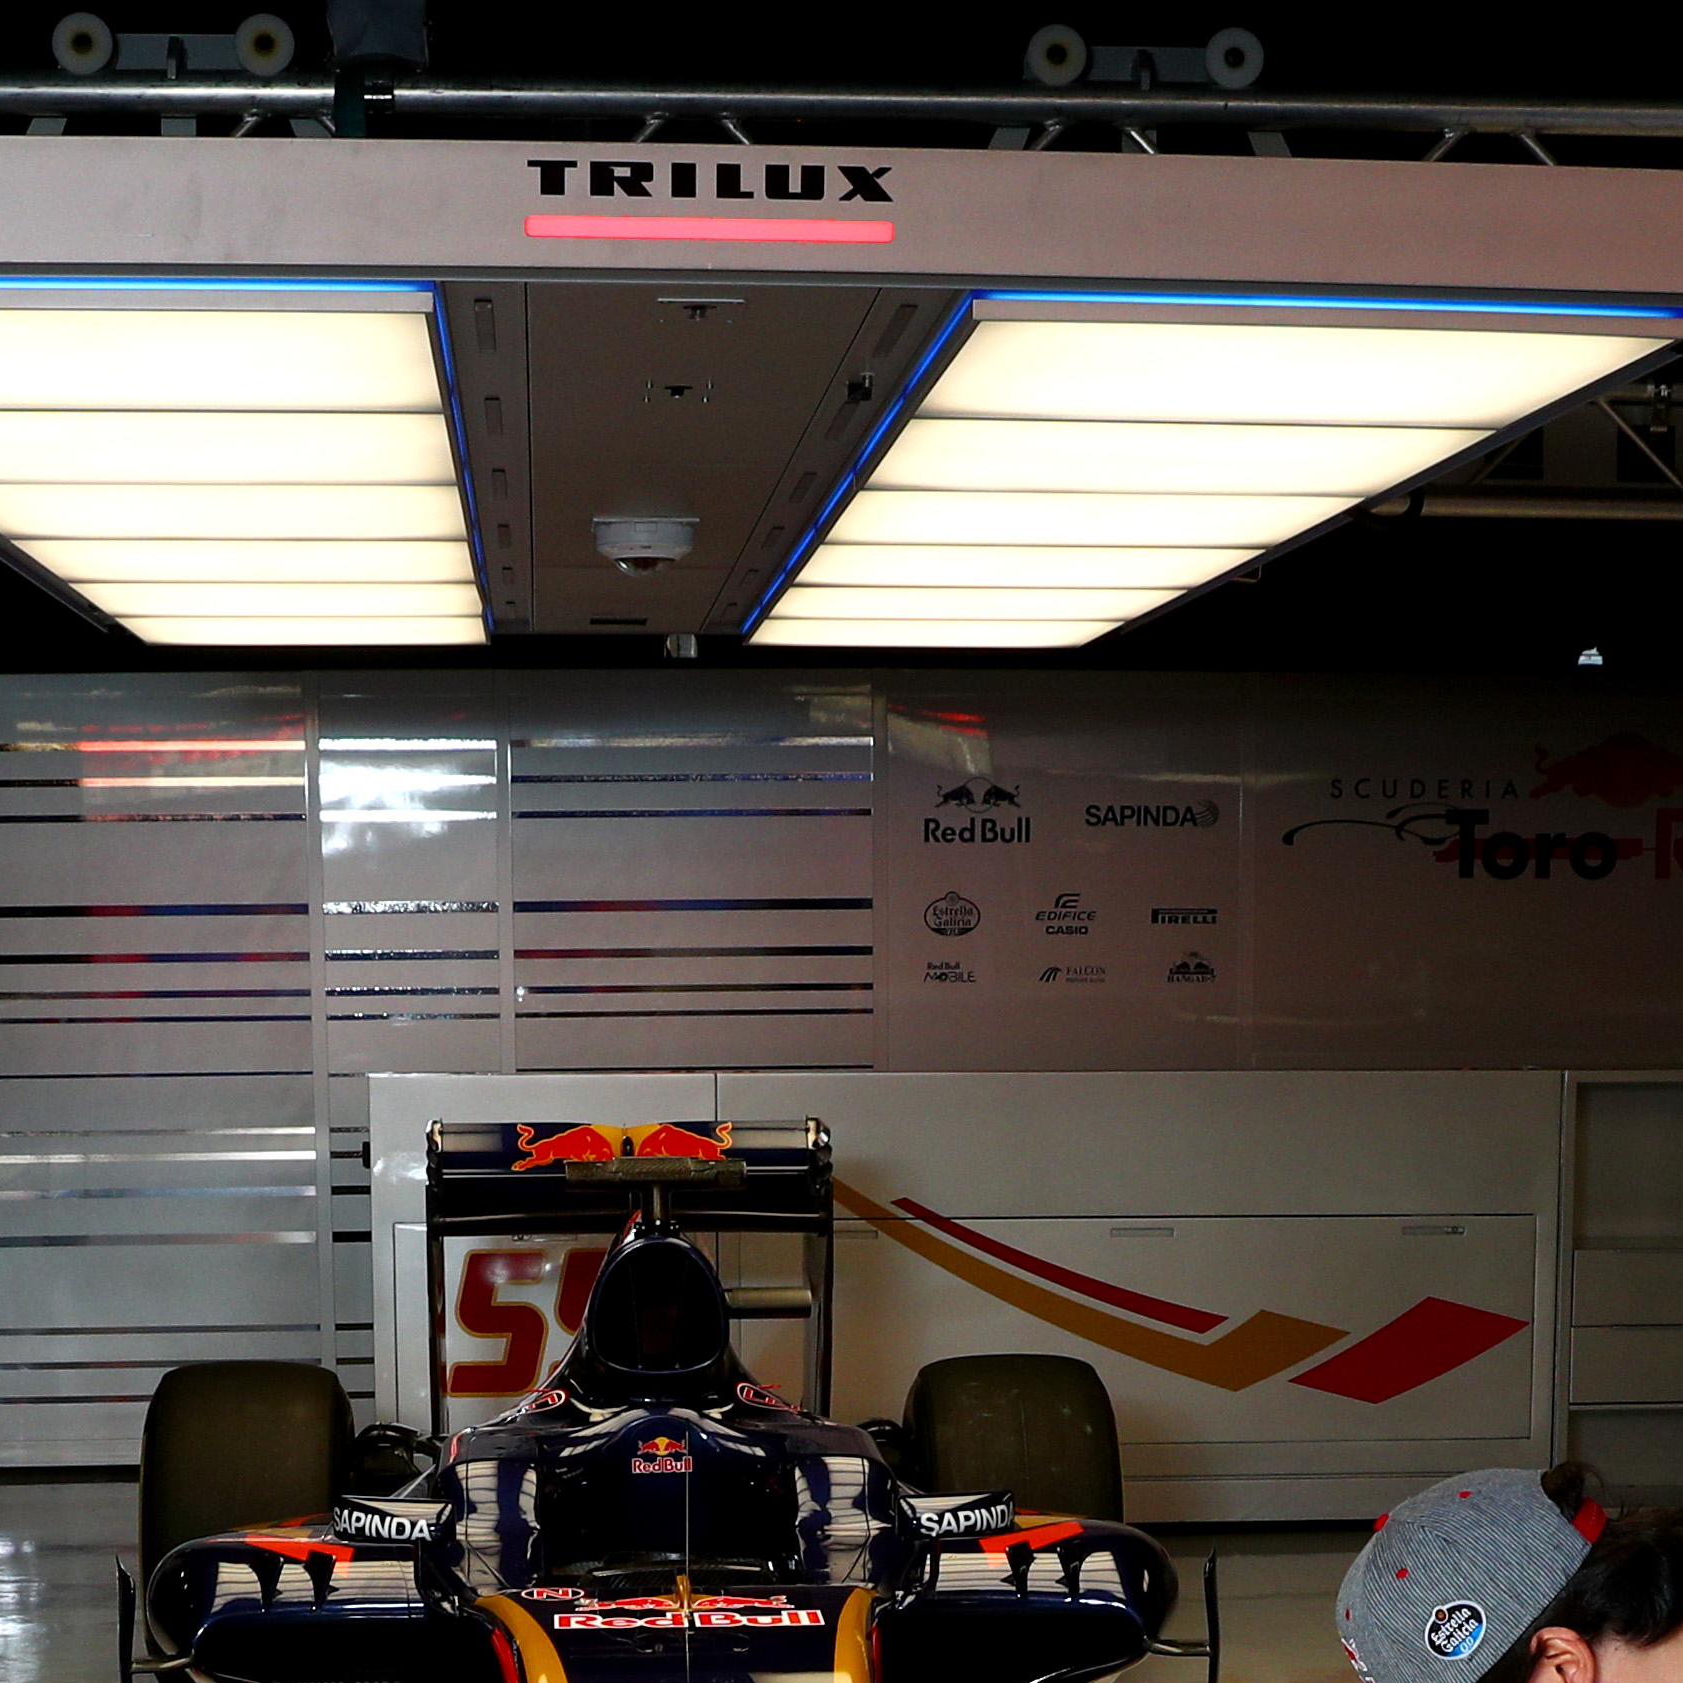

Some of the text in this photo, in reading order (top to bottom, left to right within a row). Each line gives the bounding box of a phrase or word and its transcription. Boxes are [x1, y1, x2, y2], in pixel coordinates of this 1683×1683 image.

[527, 159, 894, 202] TRILUX
[1330, 778, 1518, 799] SCUDERIA
[1084, 804, 1199, 827] SAPINDA
[923, 817, 1031, 843] Red Bull
[1444, 808, 1617, 879] Toro
[1035, 911, 1097, 921] EDIFICE
[1151, 908, 1218, 924] PIRELLI
[1045, 925, 1089, 935] CASIO
[632, 1456, 693, 1474] Red Bull
[333, 1507, 433, 1542] SAPINDA
[553, 1609, 826, 1630] Red Bull
[1430, 1608, 1472, 1646] Estrella
[1440, 1618, 1479, 1653] Galicia
